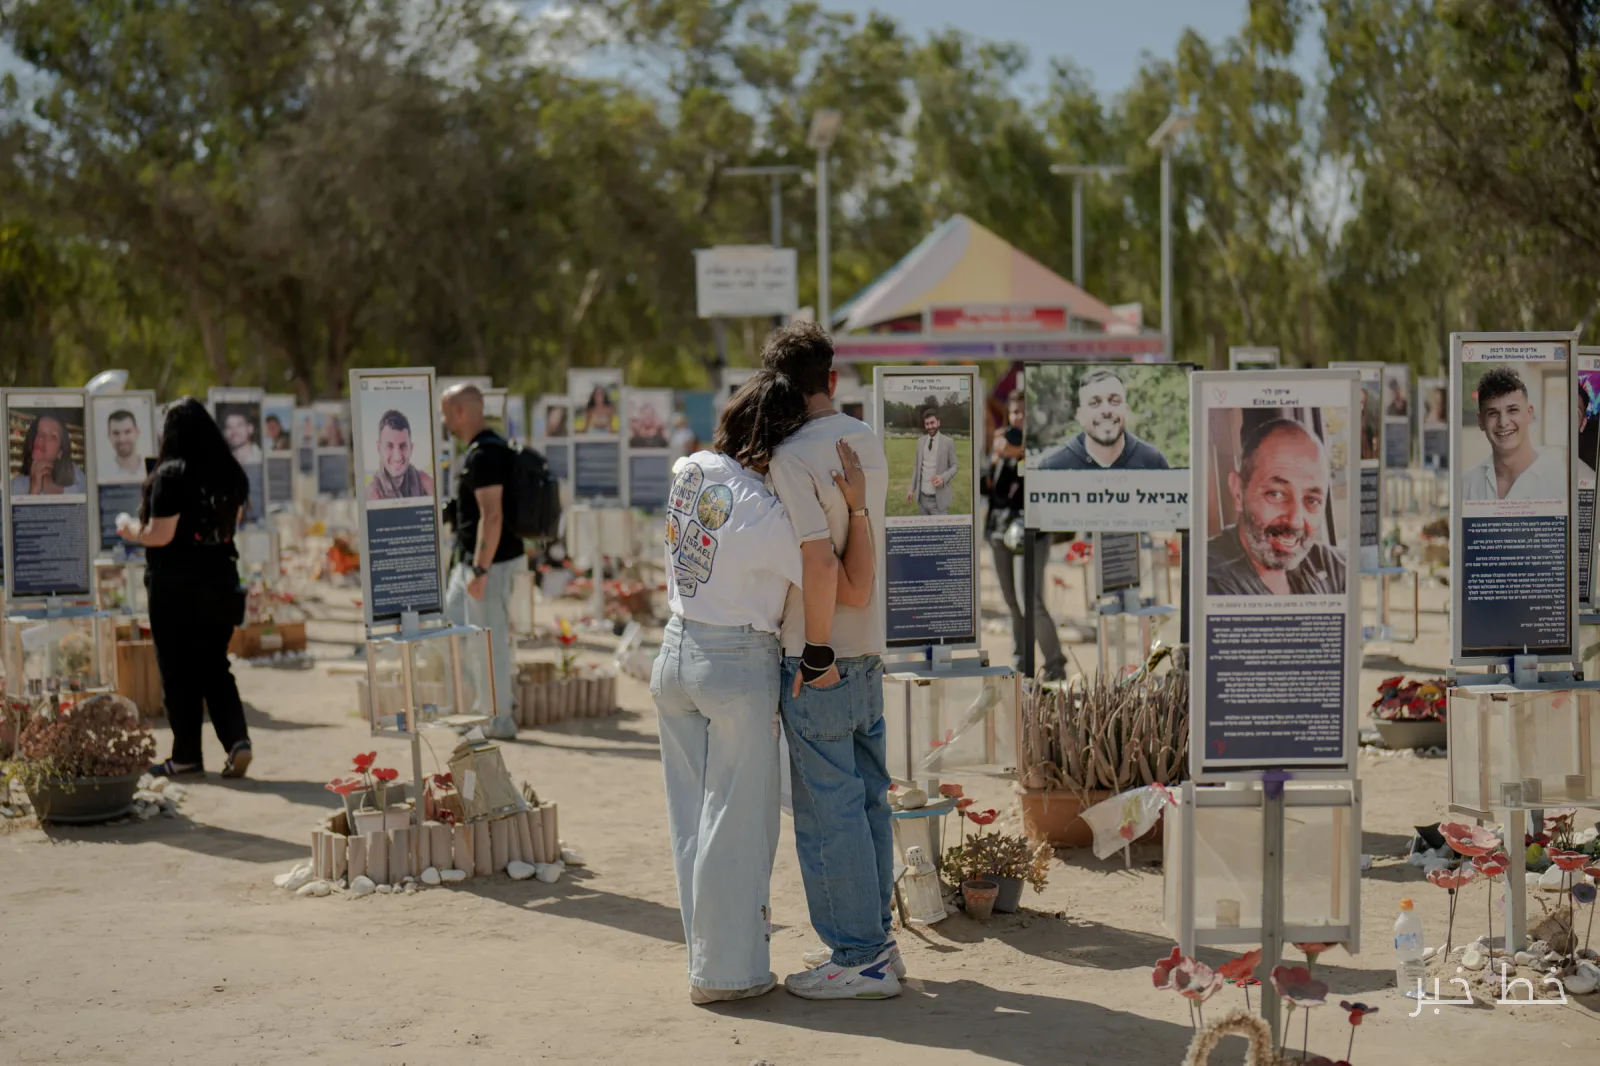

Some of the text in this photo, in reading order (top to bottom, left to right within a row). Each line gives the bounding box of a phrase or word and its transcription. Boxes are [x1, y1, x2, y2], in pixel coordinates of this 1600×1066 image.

[1029, 489, 1188, 504] אביאל שלום רחמים
[693, 528, 700, 540] I
[685, 535, 711, 560] ISRAEL
